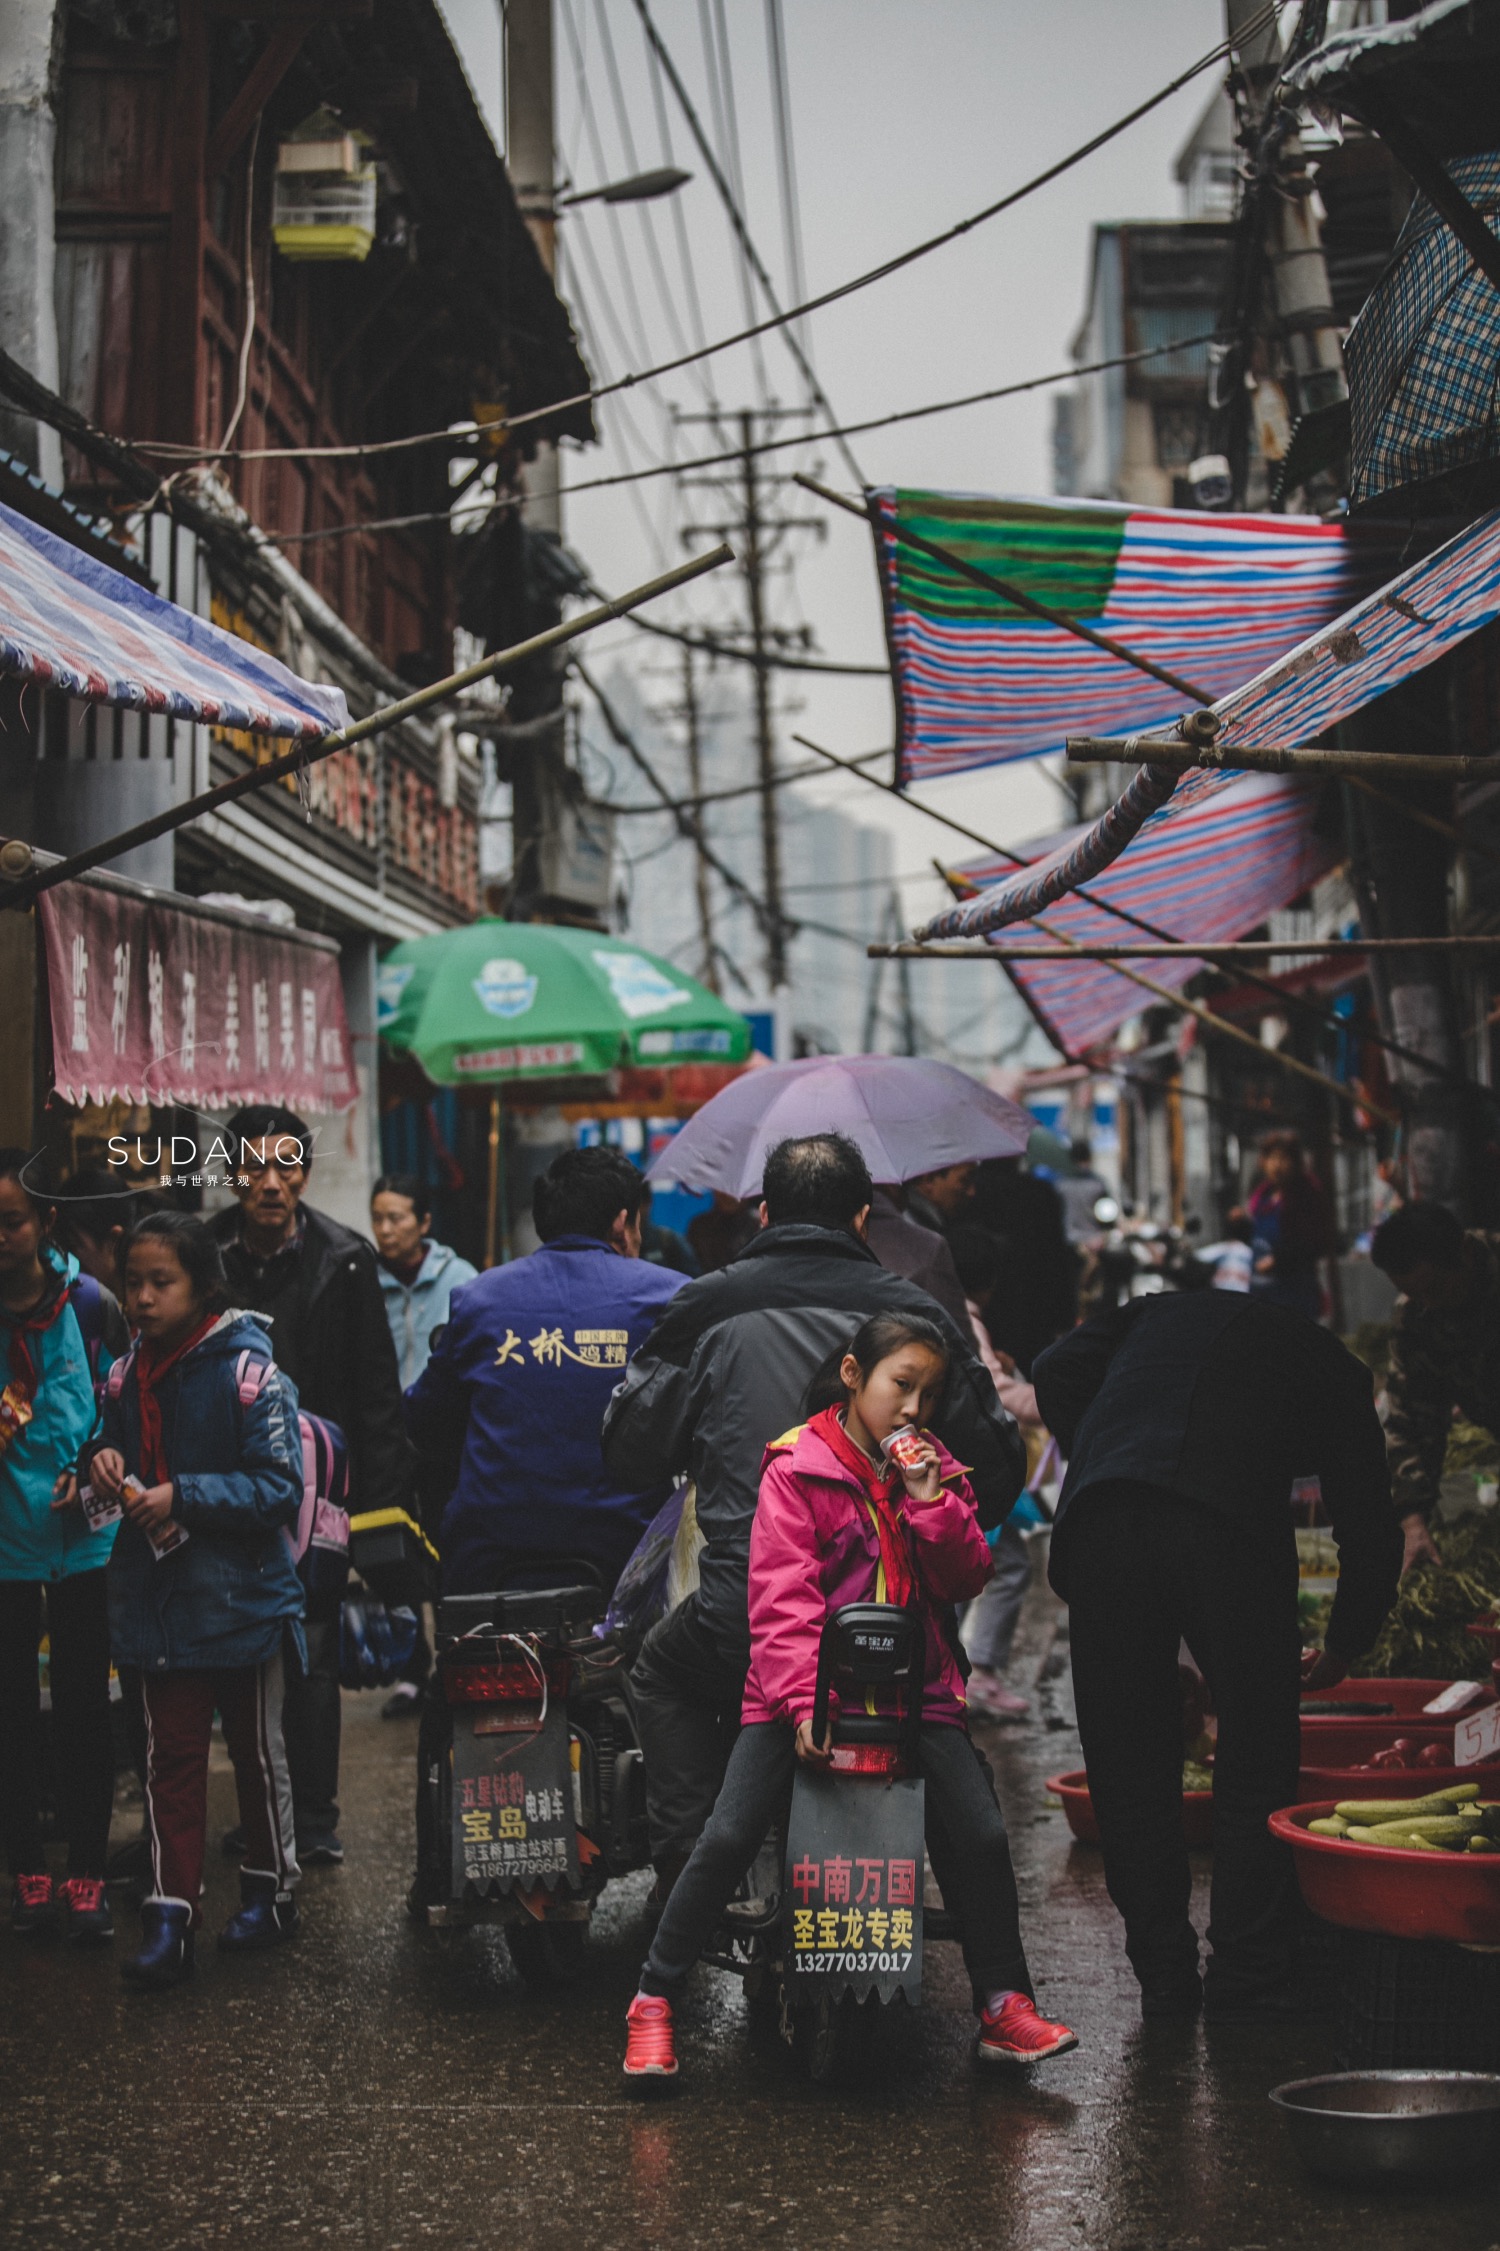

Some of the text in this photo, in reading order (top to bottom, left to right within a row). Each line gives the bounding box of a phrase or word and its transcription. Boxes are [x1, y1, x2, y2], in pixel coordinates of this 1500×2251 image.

[494, 1327, 565, 1368] 大桥
[579, 1344, 627, 1363] 鸡精
[461, 1771, 525, 1807] 五星钻豹
[525, 1787, 565, 1822] 电动车
[462, 1805, 527, 1843] 宝岛
[464, 1837, 567, 1862] 积玉桥加油站对面
[793, 1854, 916, 1905] 中南万国
[793, 1907, 913, 1950] 圣宝龙专卖
[795, 1952, 913, 1972] 13277037017
